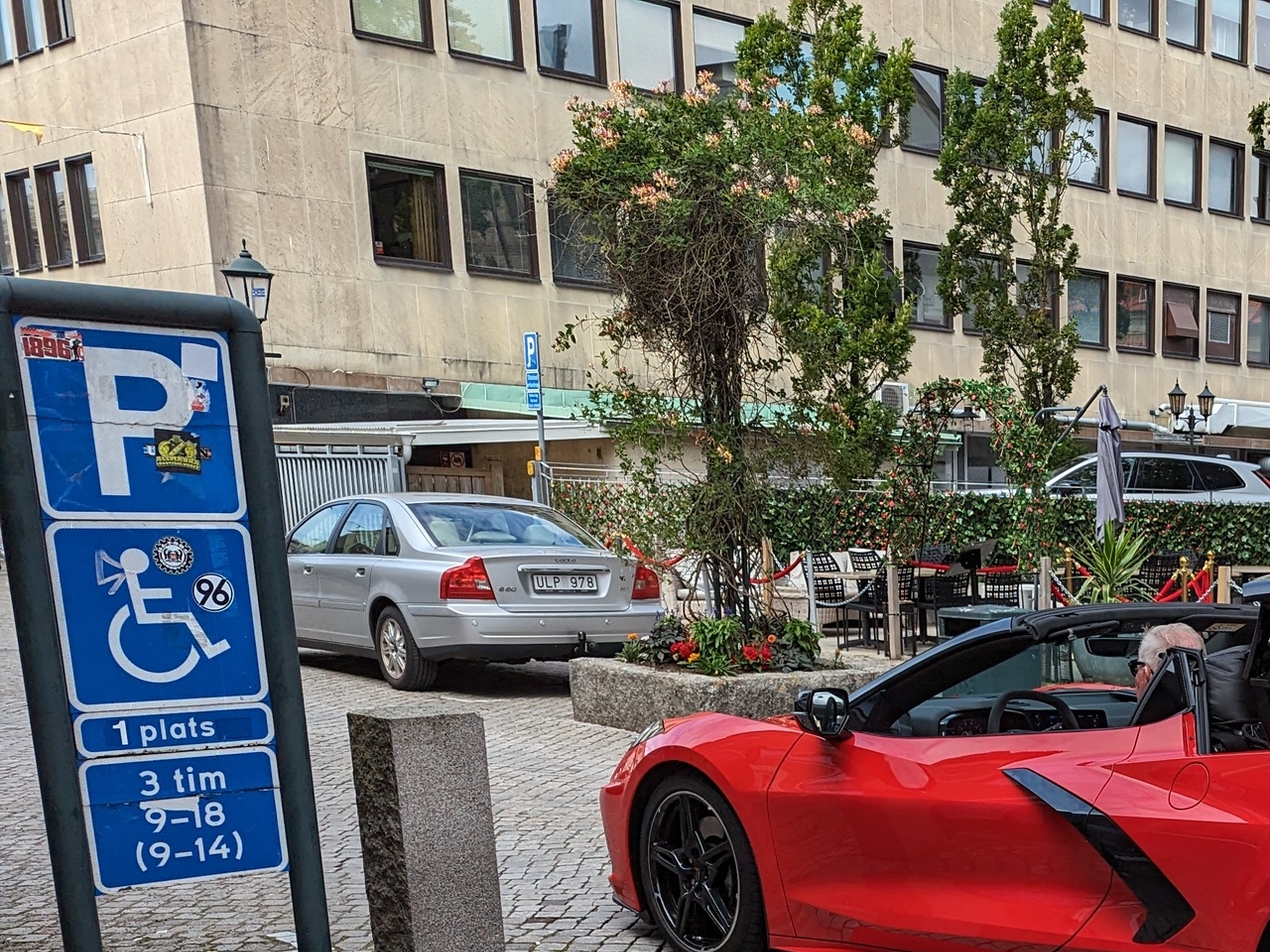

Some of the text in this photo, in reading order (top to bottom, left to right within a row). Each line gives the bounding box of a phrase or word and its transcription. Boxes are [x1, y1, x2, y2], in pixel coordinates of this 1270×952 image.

[22, 336, 71, 360] 1896
[527, 336, 535, 368] P
[84, 346, 195, 496] P
[196, 578, 230, 606] 96
[536, 574, 595, 589] ULP 978
[112, 717, 215, 747] 1 plats
[139, 766, 227, 796] 3 tim
